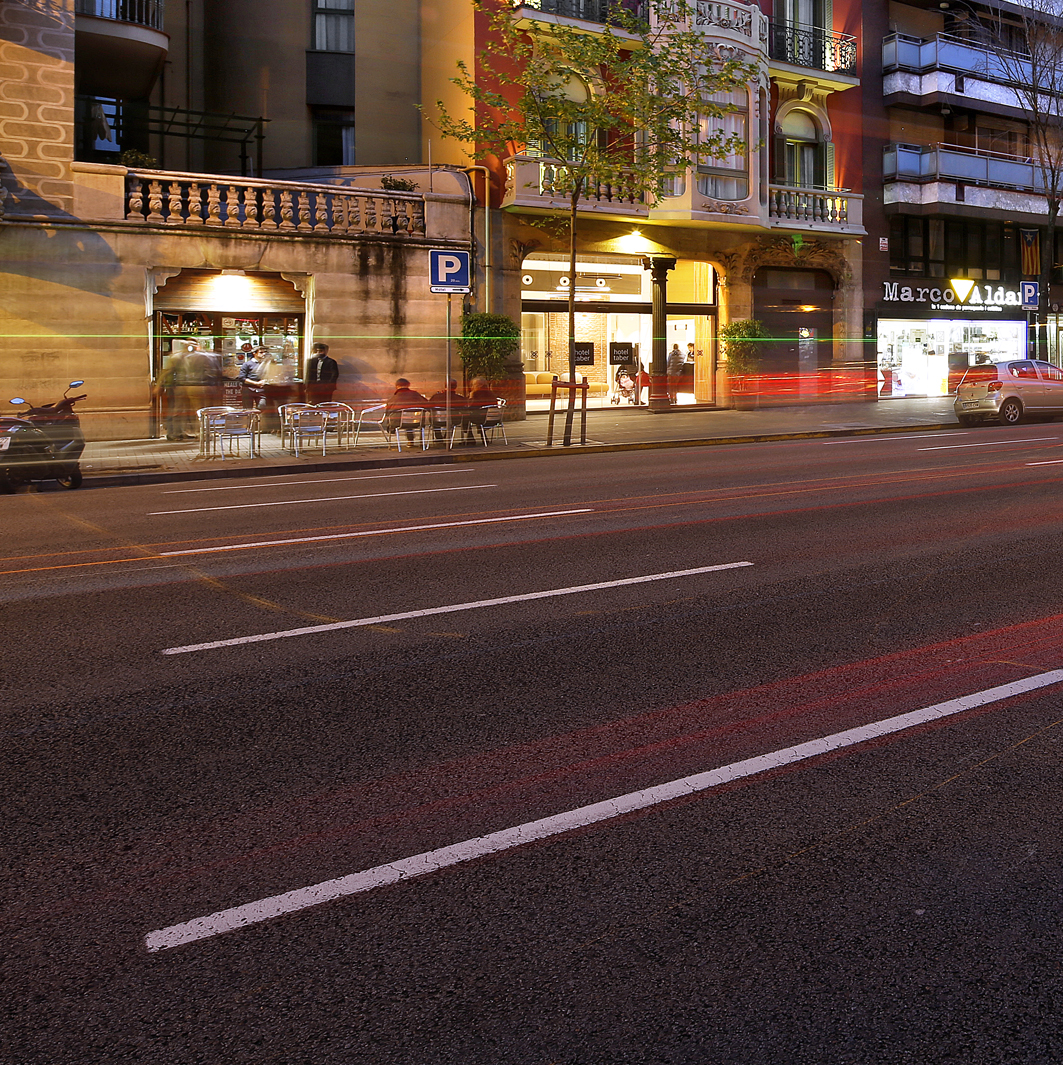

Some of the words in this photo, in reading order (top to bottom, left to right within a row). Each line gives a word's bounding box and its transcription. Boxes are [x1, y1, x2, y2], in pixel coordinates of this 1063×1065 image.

[438, 255, 461, 282] P
[883, 281, 955, 303] Marco
[1024, 284, 1036, 303] P
